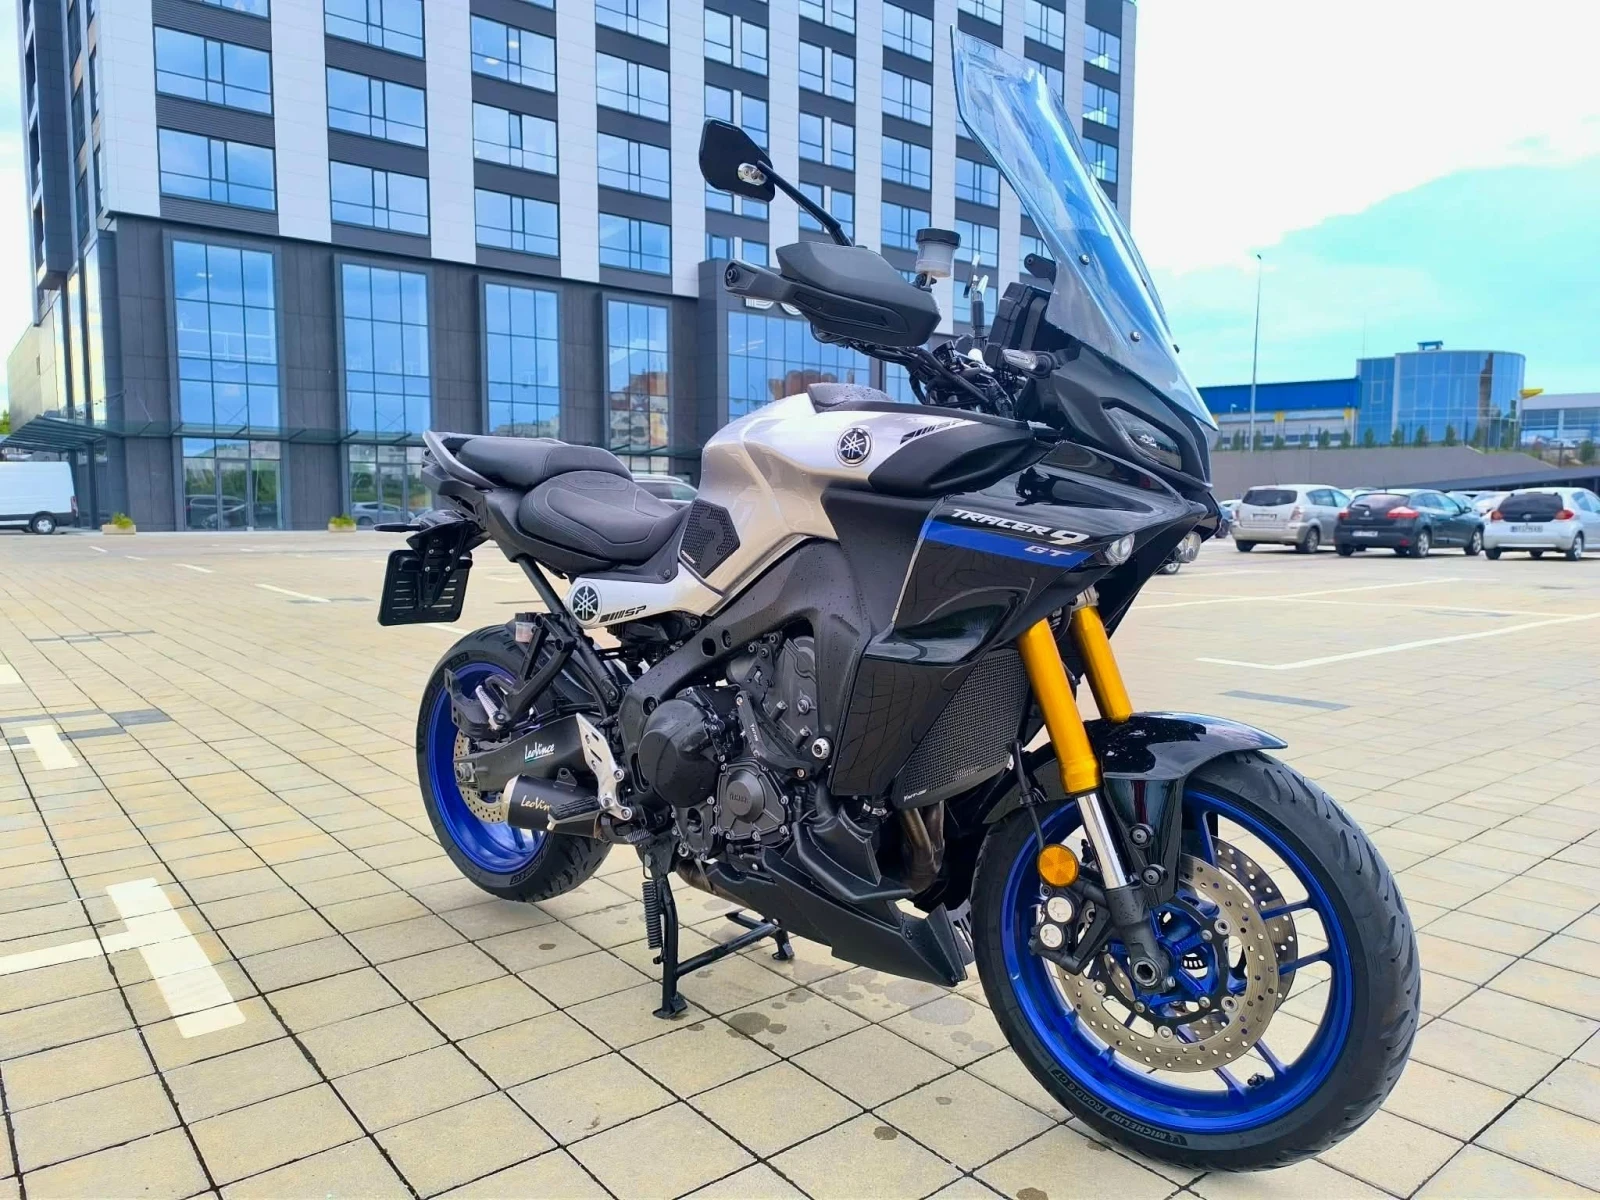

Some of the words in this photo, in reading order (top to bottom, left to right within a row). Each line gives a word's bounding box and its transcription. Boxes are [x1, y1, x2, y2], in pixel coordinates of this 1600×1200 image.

[951, 508, 1052, 536] TRACER
[1048, 530, 1090, 545] 9
[1024, 545, 1073, 557] GT
[624, 604, 647, 618] SP
[524, 741, 555, 760] LeoVince
[520, 794, 550, 812] LeoVin
[1074, 1087, 1104, 1112] ROAD
[1110, 1113, 1168, 1140] MICHELIN
